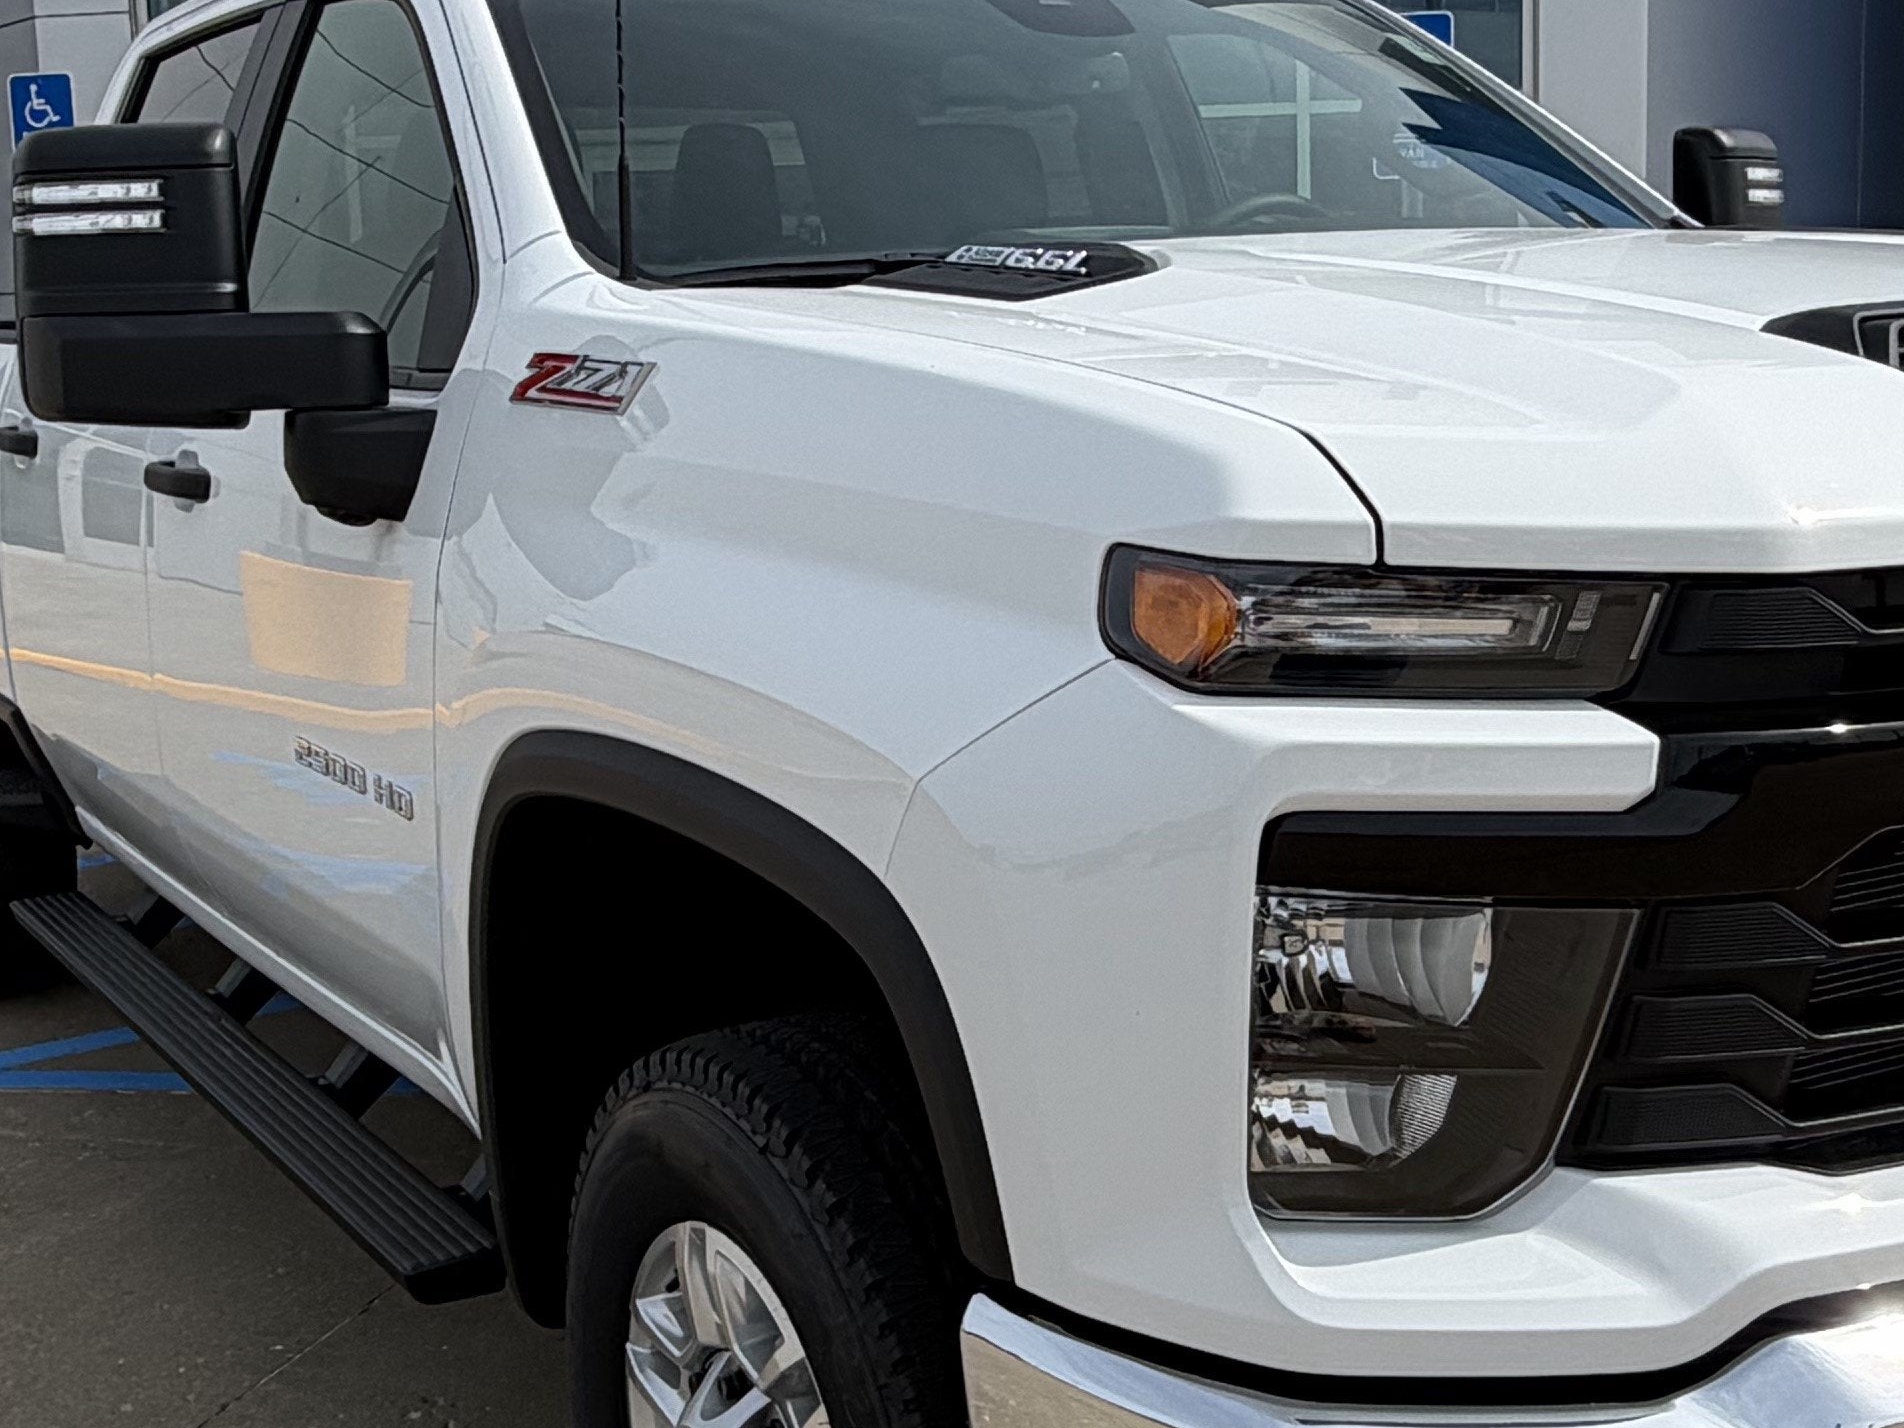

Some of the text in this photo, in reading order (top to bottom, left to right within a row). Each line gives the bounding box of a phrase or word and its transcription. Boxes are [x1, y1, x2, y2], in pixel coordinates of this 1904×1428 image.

[508, 352, 658, 417] Z71
[294, 734, 415, 822] 2500 HD
